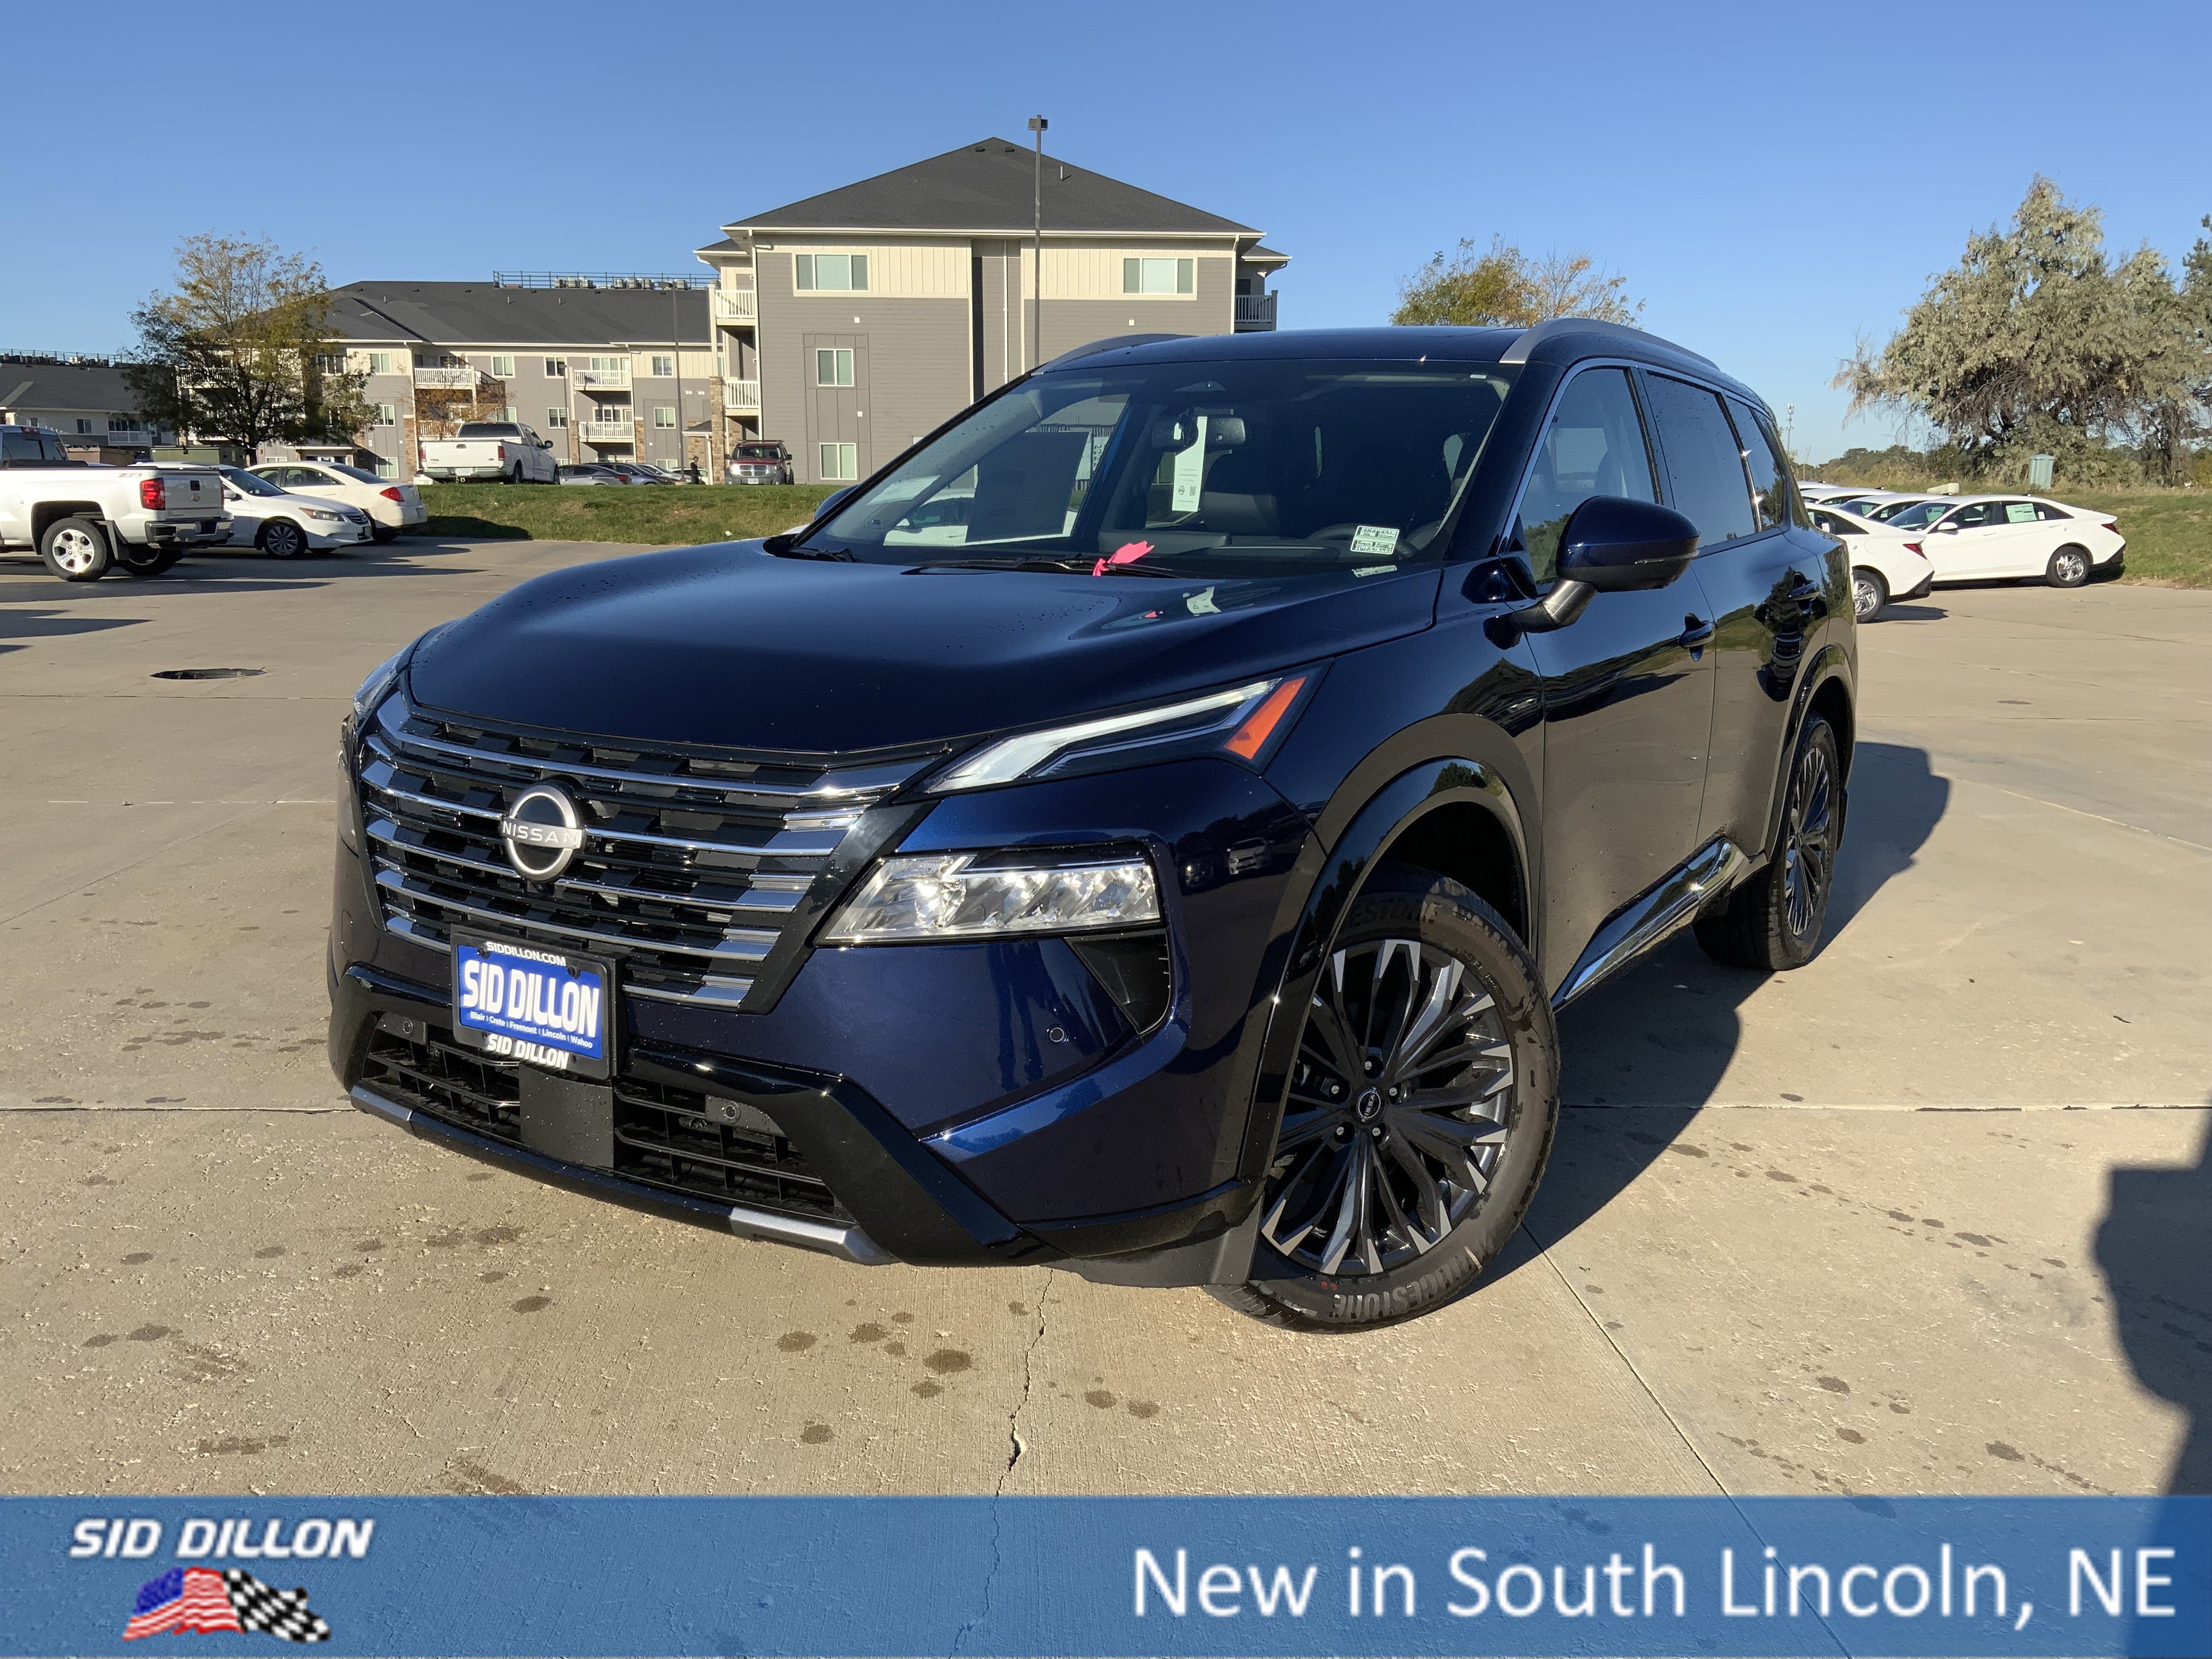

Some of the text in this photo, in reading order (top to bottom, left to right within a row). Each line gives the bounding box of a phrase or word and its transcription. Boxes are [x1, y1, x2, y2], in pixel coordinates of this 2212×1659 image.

[503, 821, 579, 845] NISSAN
[486, 941, 567, 967] SIDDILLON.COM
[462, 959, 600, 1038] SID DILLON
[470, 1011, 593, 1048] Blair Crete Fremont Lincoln Wahoo
[487, 1034, 569, 1069] SID DILLON
[1361, 1087, 1378, 1122] NISSAN
